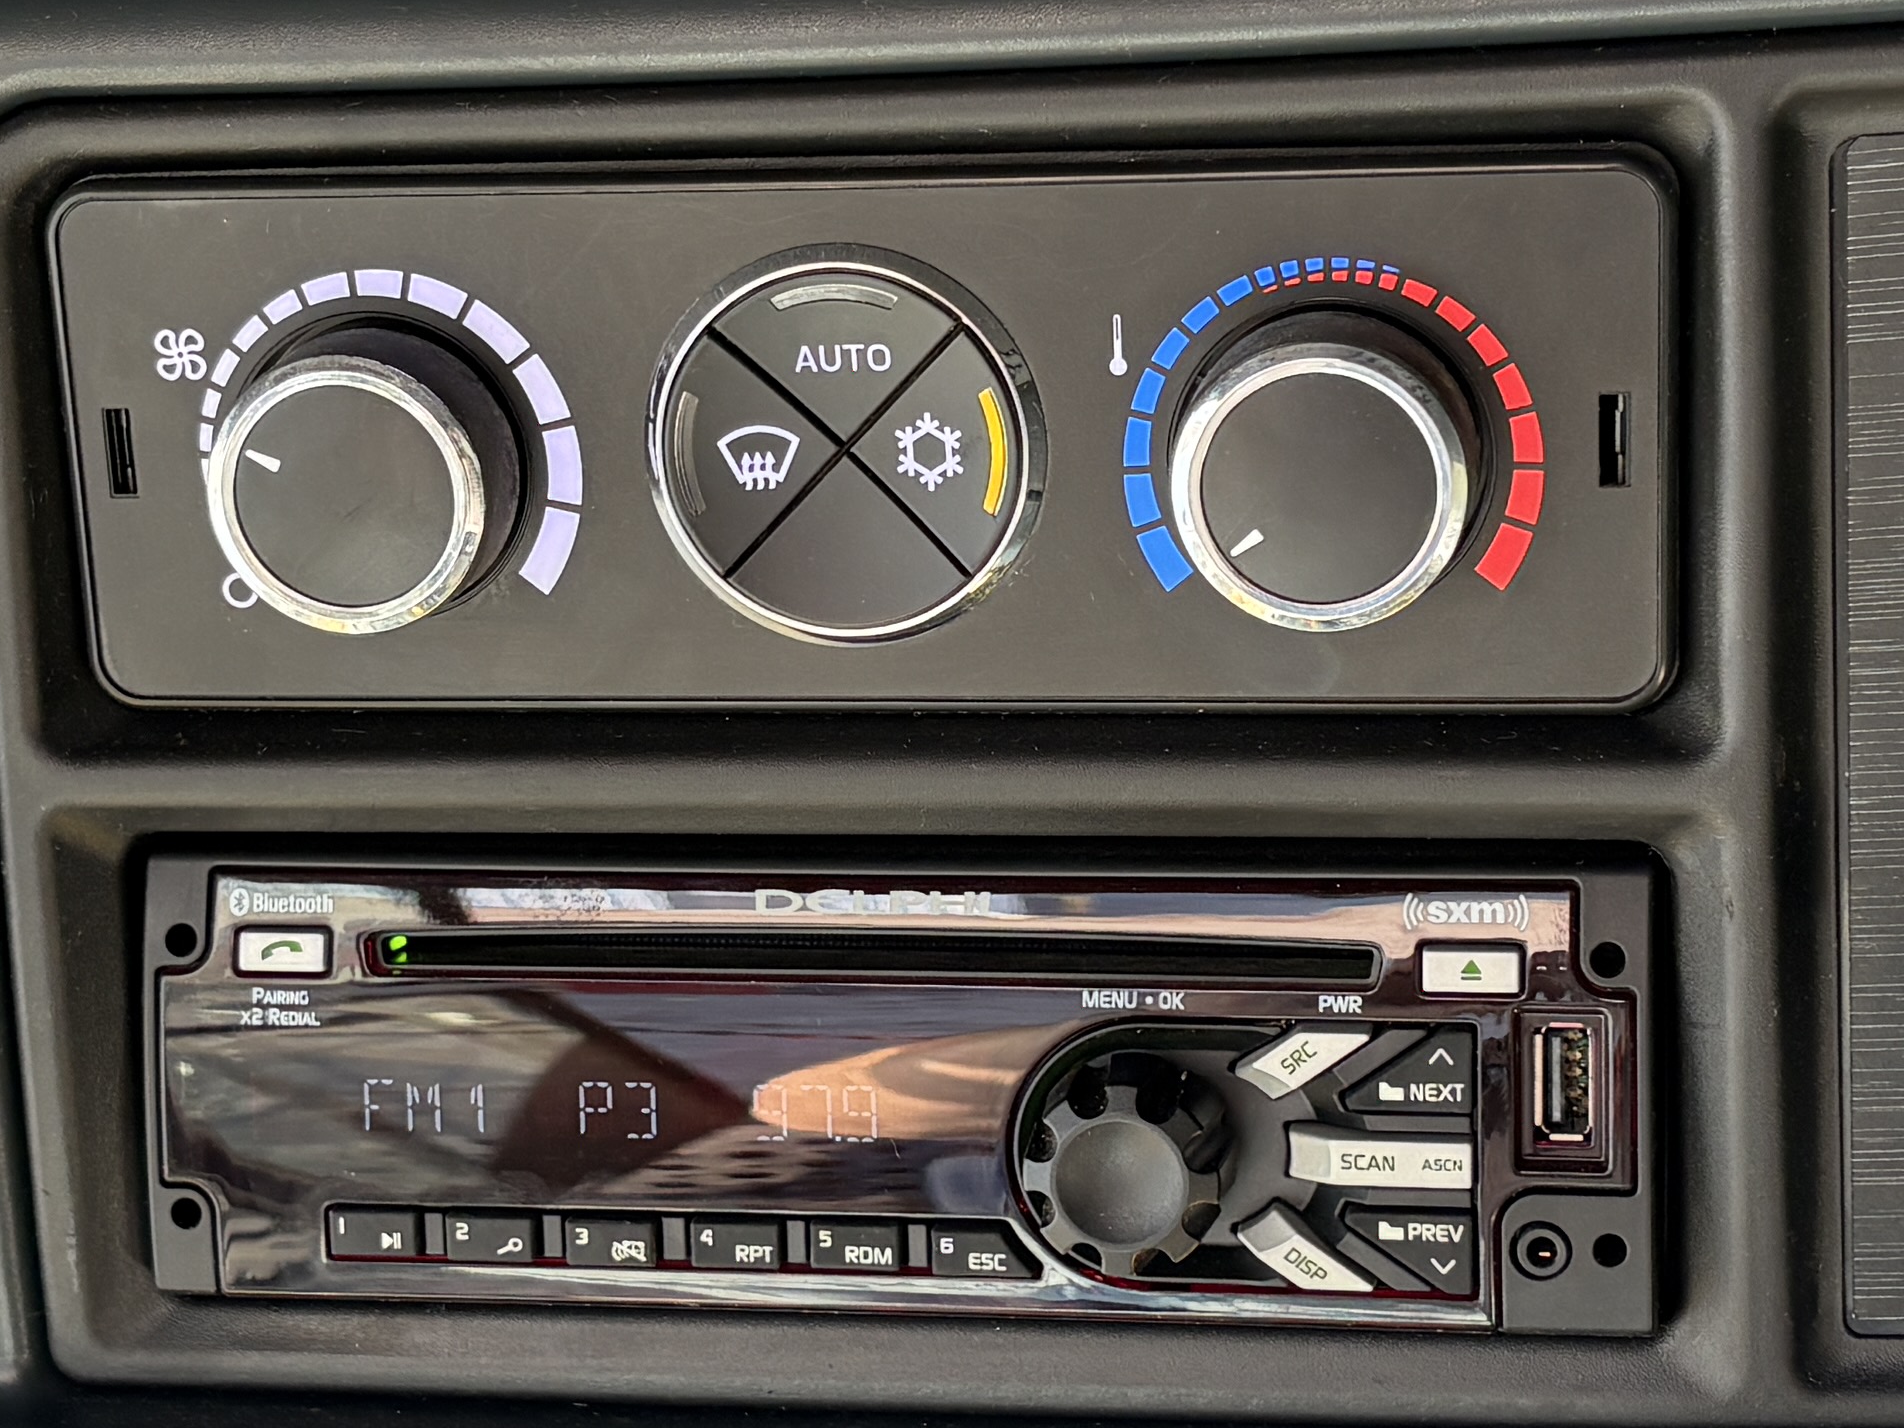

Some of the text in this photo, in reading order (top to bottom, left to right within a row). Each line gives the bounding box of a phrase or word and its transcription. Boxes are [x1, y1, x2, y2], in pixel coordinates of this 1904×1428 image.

[795, 343, 892, 373] AUTO
[252, 892, 334, 913] Bluetooth
[754, 888, 992, 915] DELPHI
[1426, 900, 1506, 924] sxm
[1081, 990, 1185, 1010] MENU OK
[1318, 995, 1363, 1013] PWR
[1280, 1040, 1318, 1075] SRC
[1409, 1083, 1465, 1102] NEXT
[578, 1080, 658, 1139] P3
[1340, 1153, 1463, 1172] SCAN ASCN
[338, 1216, 345, 1234] 1
[455, 1222, 470, 1241] 2
[1408, 1222, 1464, 1243] PREV
[574, 1227, 589, 1245] 3
[699, 1228, 713, 1246] 4
[818, 1230, 832, 1247] 5
[939, 1237, 954, 1254] 6
[734, 1244, 773, 1263] RPT
[844, 1246, 893, 1265] RDM
[968, 1252, 1007, 1271] ESC
[1283, 1246, 1329, 1281] DISP
